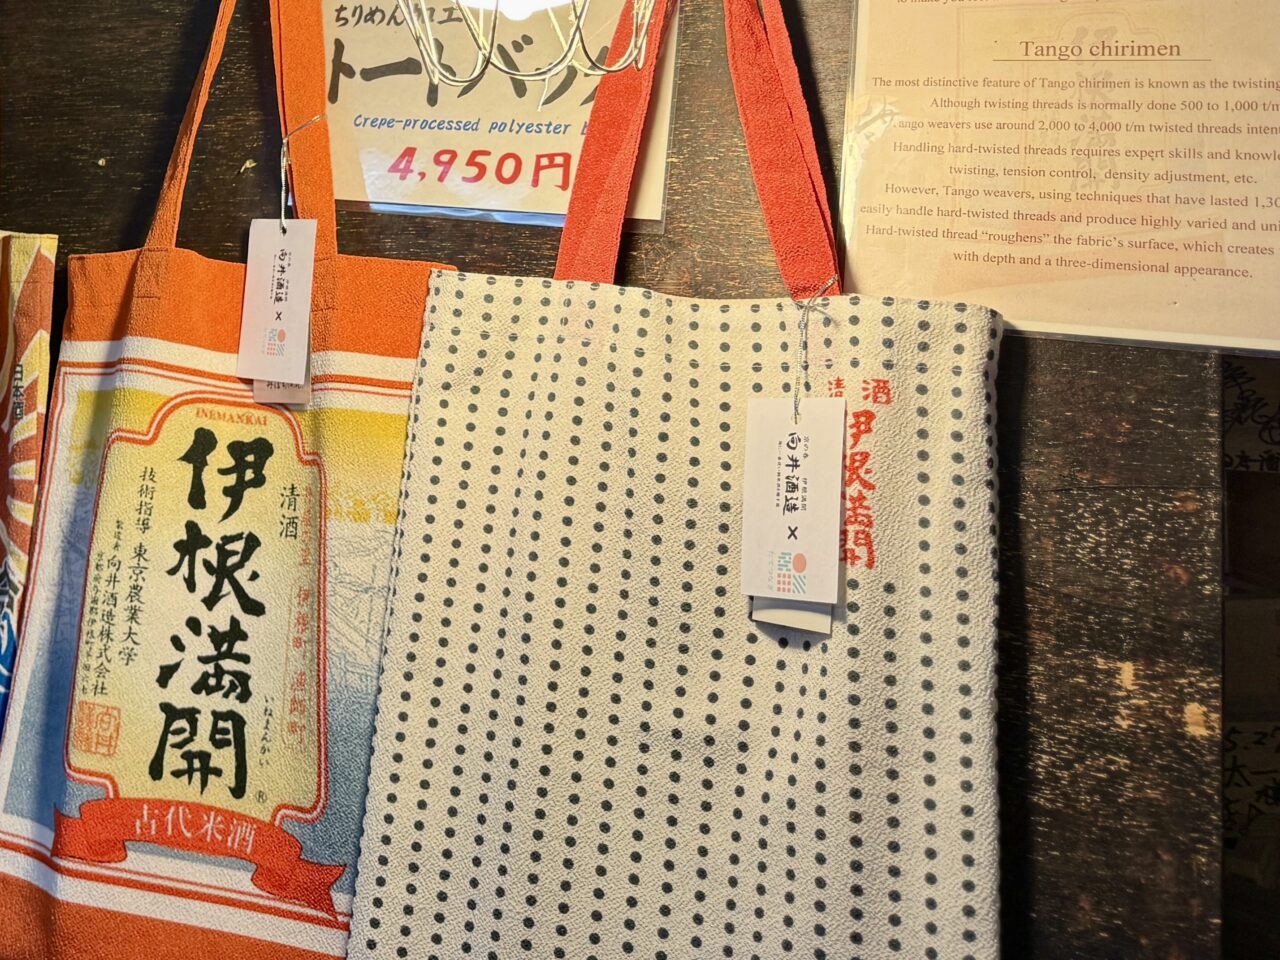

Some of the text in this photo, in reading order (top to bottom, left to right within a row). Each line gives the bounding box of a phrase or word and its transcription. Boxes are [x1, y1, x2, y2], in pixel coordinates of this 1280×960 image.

[1020, 40, 1181, 62] Tango chirimen
[871, 76, 1229, 91] The most distinctive feature of Tango chirimen is known as the
[930, 97, 1259, 113] Although twisting threads is normally done 500 to 1,000
[353, 114, 480, 132] Crepe-processed
[488, 119, 571, 135] polyester
[893, 141, 1231, 161] Handling hard-twisted threads requires expert skills and
[387, 146, 572, 191] 4,950円
[1003, 166, 1046, 177] tension
[1104, 168, 1150, 183] density
[866, 224, 939, 238] Hard-twisted
[942, 228, 978, 240] thread
[1053, 233, 1072, 245] the
[1182, 240, 1223, 253] which
[1227, 245, 1275, 256] creates
[953, 250, 979, 262] with
[982, 252, 1016, 266] depth
[1019, 255, 1041, 266] and
[1044, 258, 1052, 267] a
[1055, 256, 1169, 273] three-dimensional
[782, 432, 801, 516] 向井酒造
[279, 483, 301, 540] 清酒
[118, 542, 150, 666] 東京農業大学
[149, 427, 275, 800] 伊根満開
[91, 554, 122, 697] 向井酒造株式会社
[134, 803, 257, 855] 古代米酒
